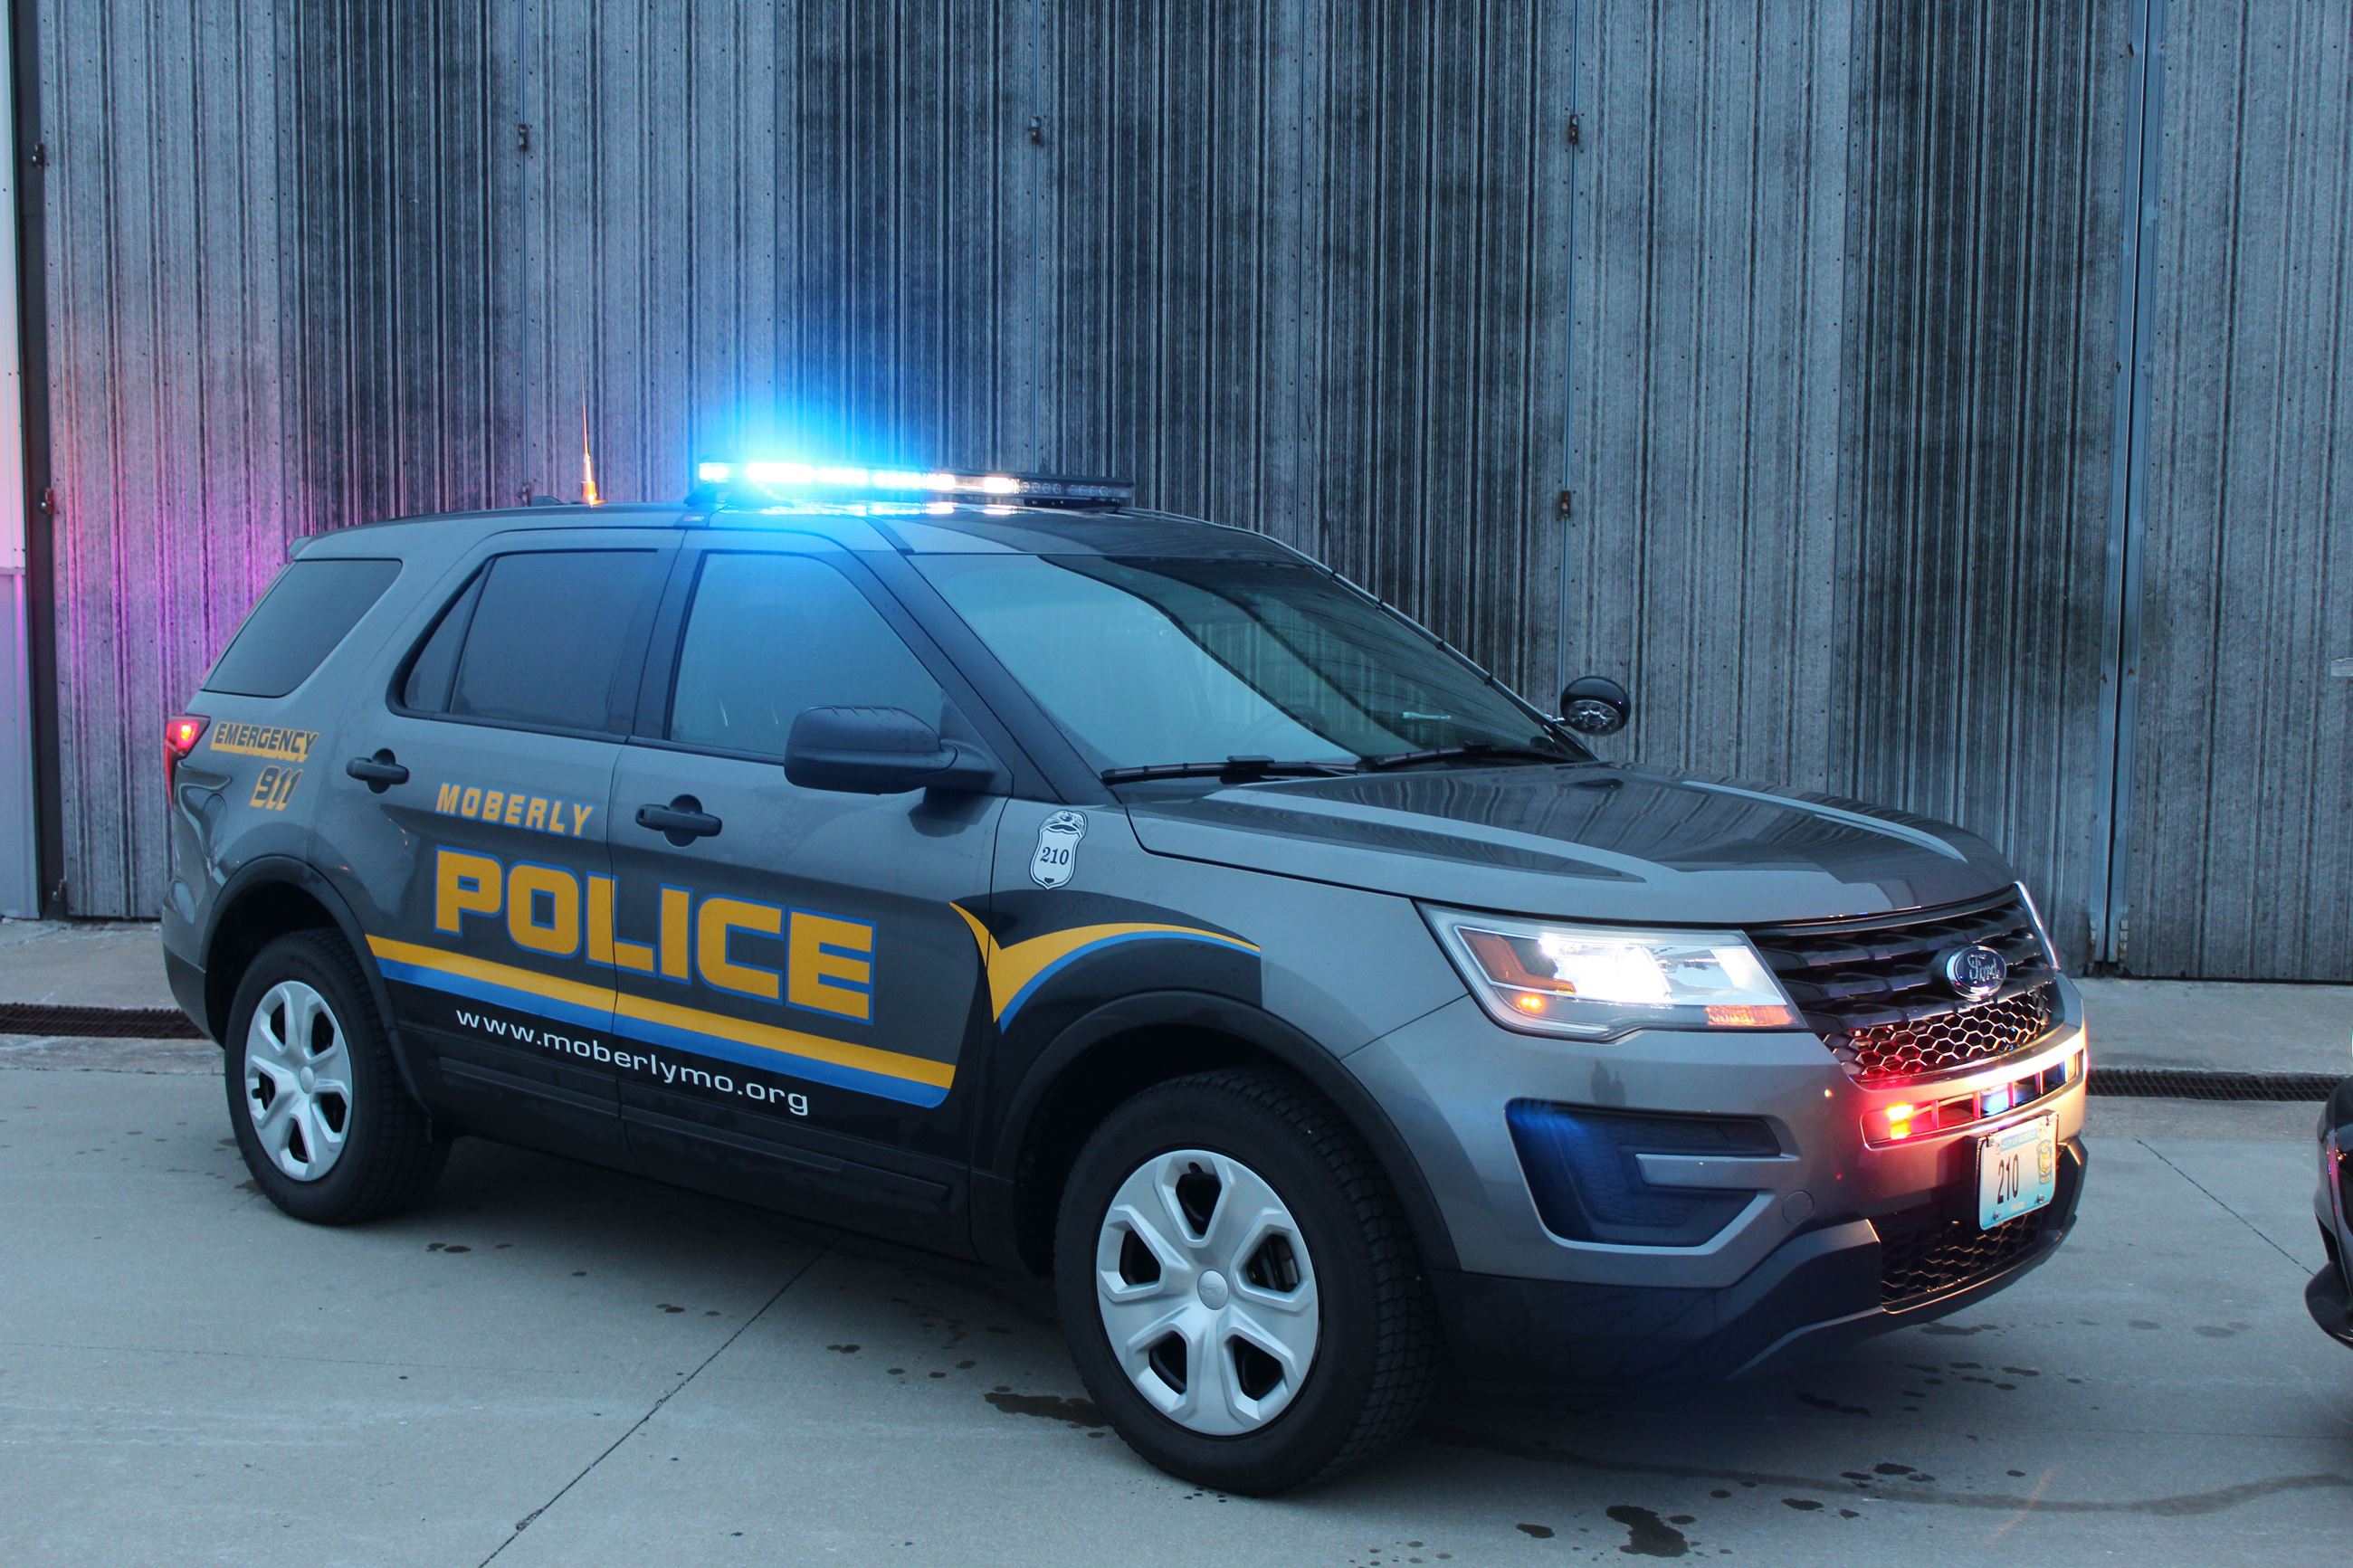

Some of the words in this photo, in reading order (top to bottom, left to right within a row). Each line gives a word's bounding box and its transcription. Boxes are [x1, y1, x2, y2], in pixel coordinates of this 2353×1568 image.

[211, 721, 319, 762] EMERGENCY
[250, 765, 303, 811] 911
[435, 782, 594, 838] MOBERLY
[1039, 846, 1070, 865] 210
[433, 844, 878, 1025] POLICE
[1967, 953, 2003, 984] Ford
[456, 1009, 809, 1117] www.moberlymo.org
[1996, 1154, 2019, 1205] 210
